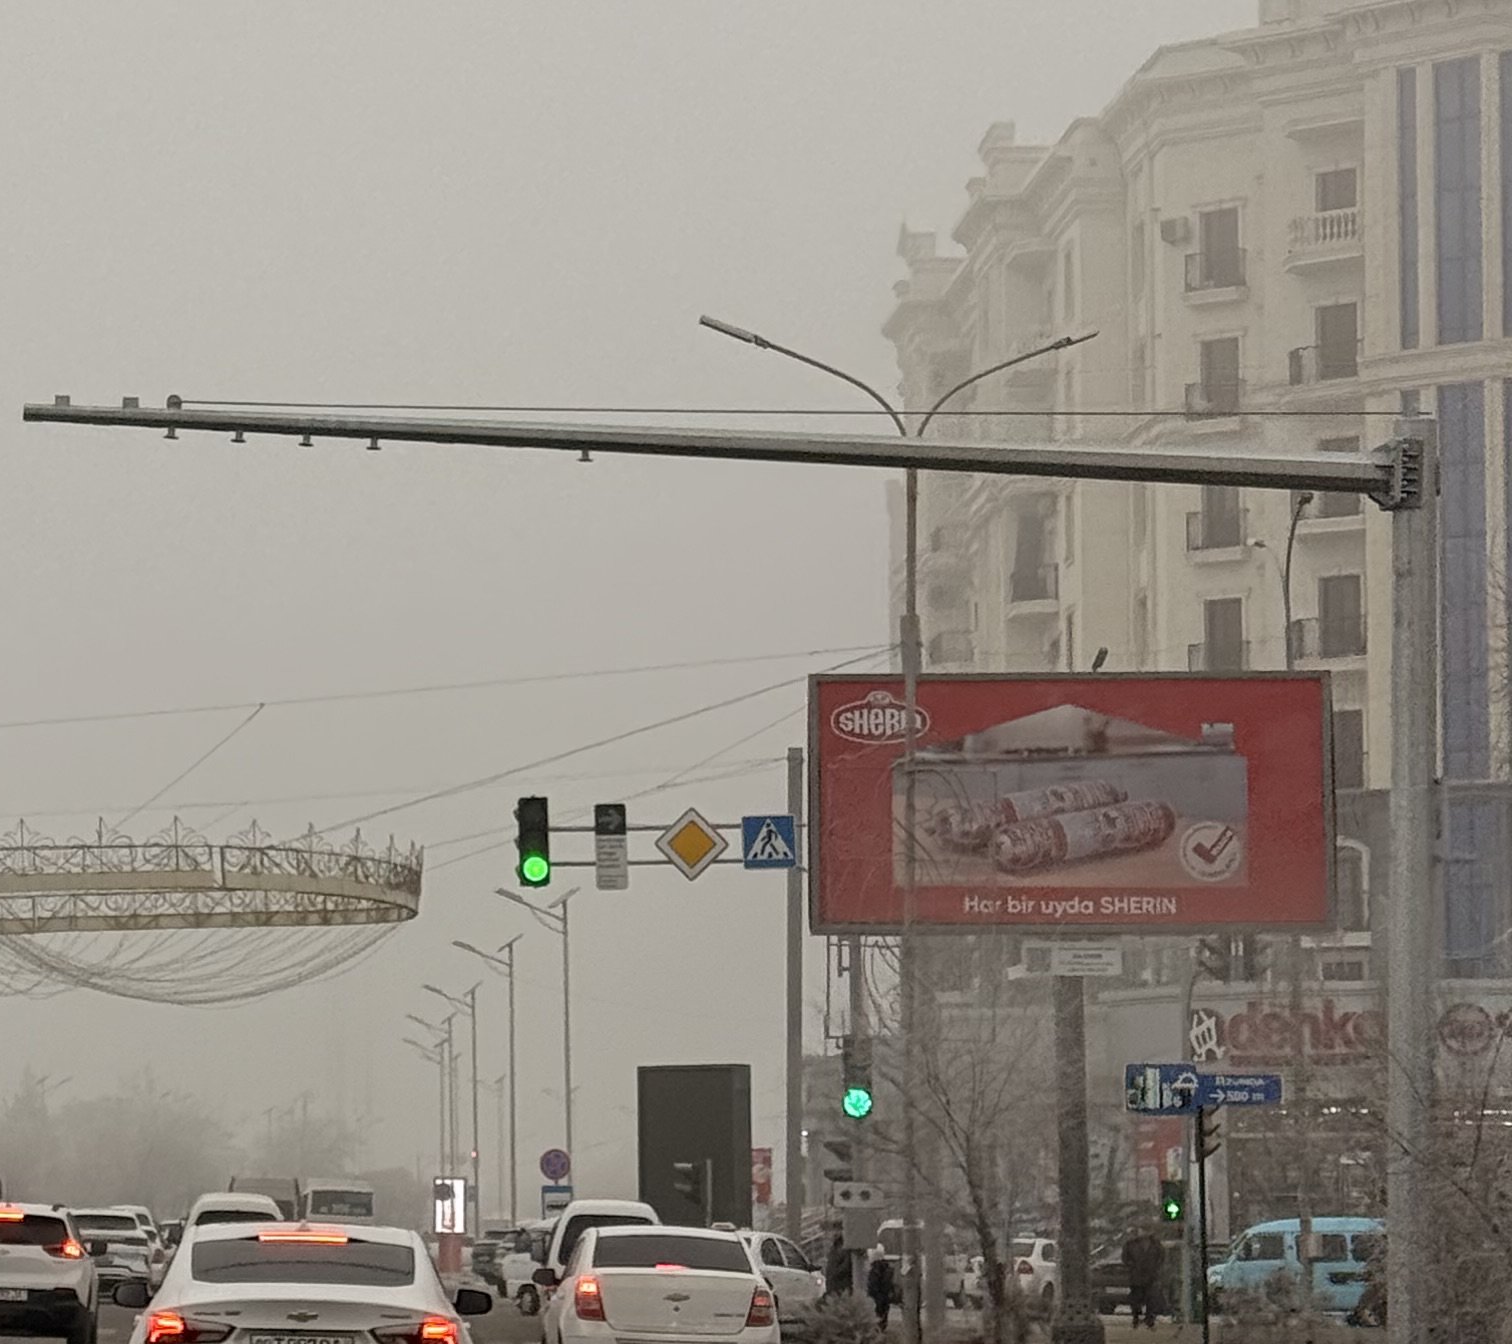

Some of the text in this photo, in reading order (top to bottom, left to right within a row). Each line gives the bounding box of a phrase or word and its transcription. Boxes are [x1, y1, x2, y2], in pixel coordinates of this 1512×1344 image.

[963, 895, 1177, 918] Har bir uyda SHERIN
